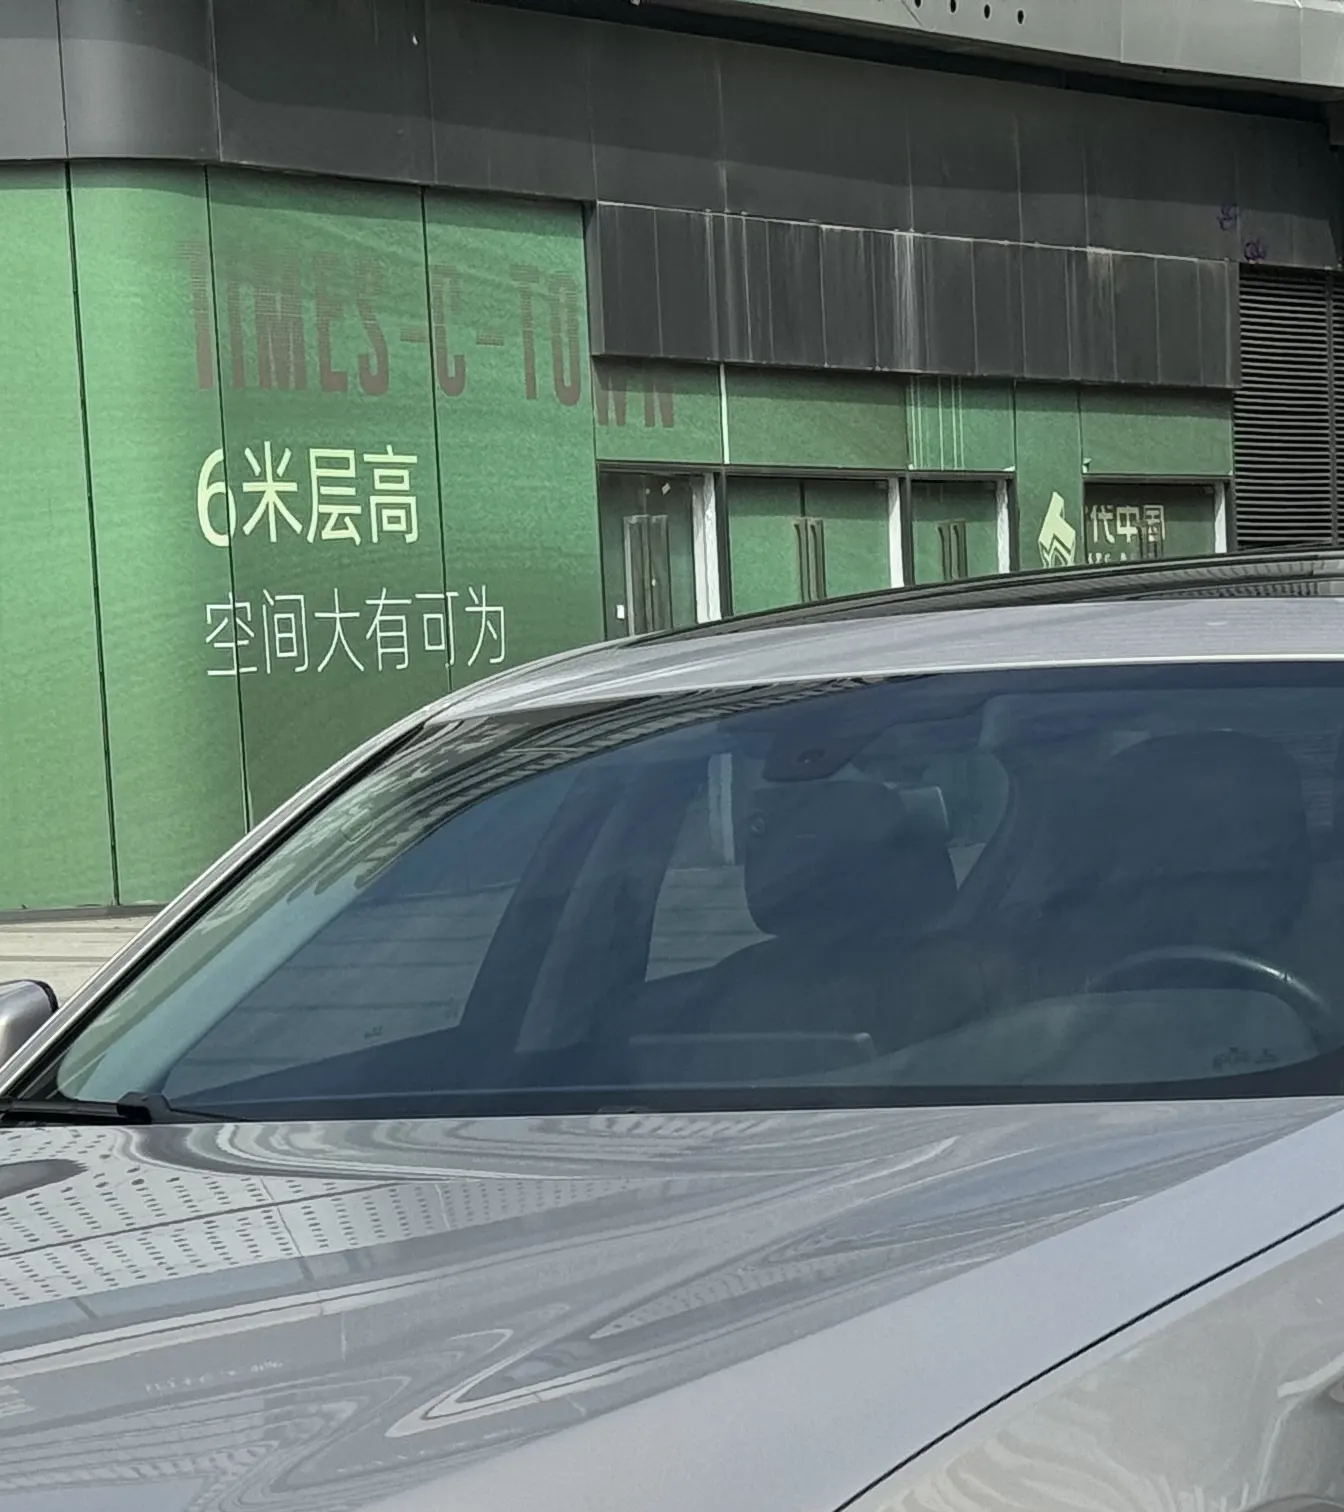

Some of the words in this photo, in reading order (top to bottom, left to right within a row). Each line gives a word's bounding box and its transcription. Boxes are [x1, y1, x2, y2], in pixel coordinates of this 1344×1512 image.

[197, 440, 419, 547] 6米层高
[205, 584, 506, 676] 空间大有可为
